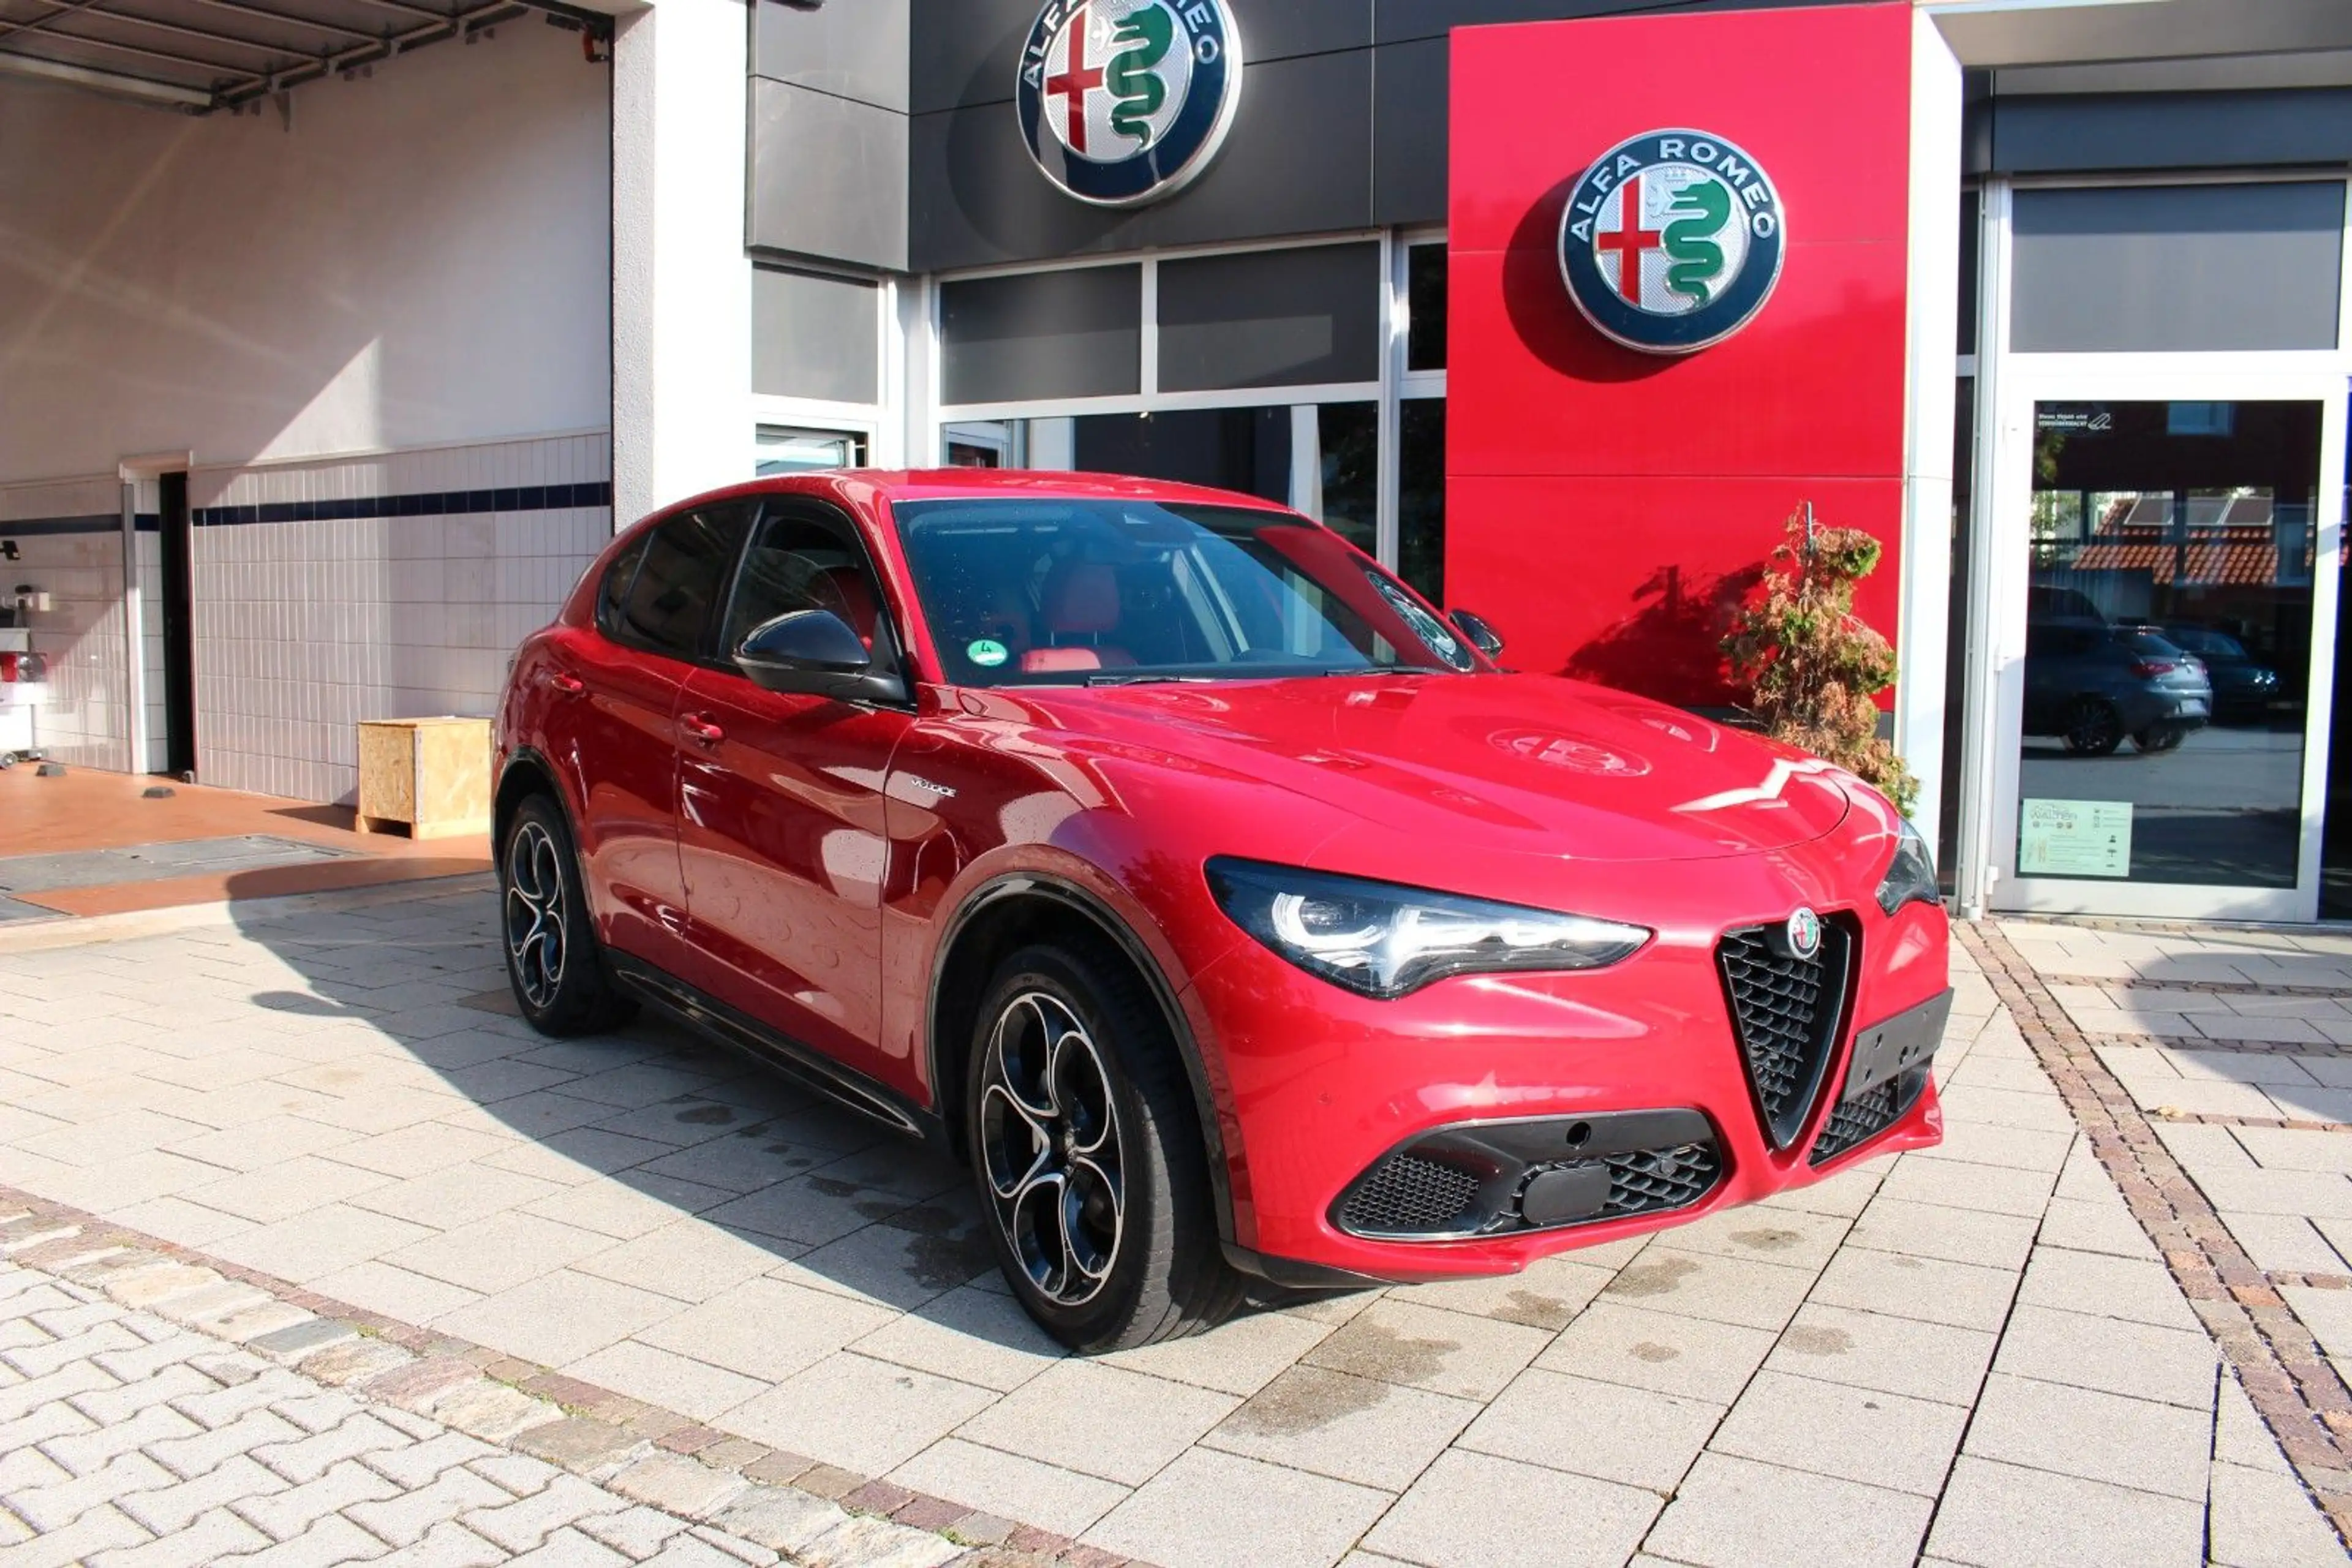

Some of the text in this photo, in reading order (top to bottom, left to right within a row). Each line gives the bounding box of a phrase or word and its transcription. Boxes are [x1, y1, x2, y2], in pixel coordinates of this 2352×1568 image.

[1023, 0, 1077, 89] ALF
[1571, 138, 1776, 243] ALFA ROMEO
[981, 642, 992, 653] 4
